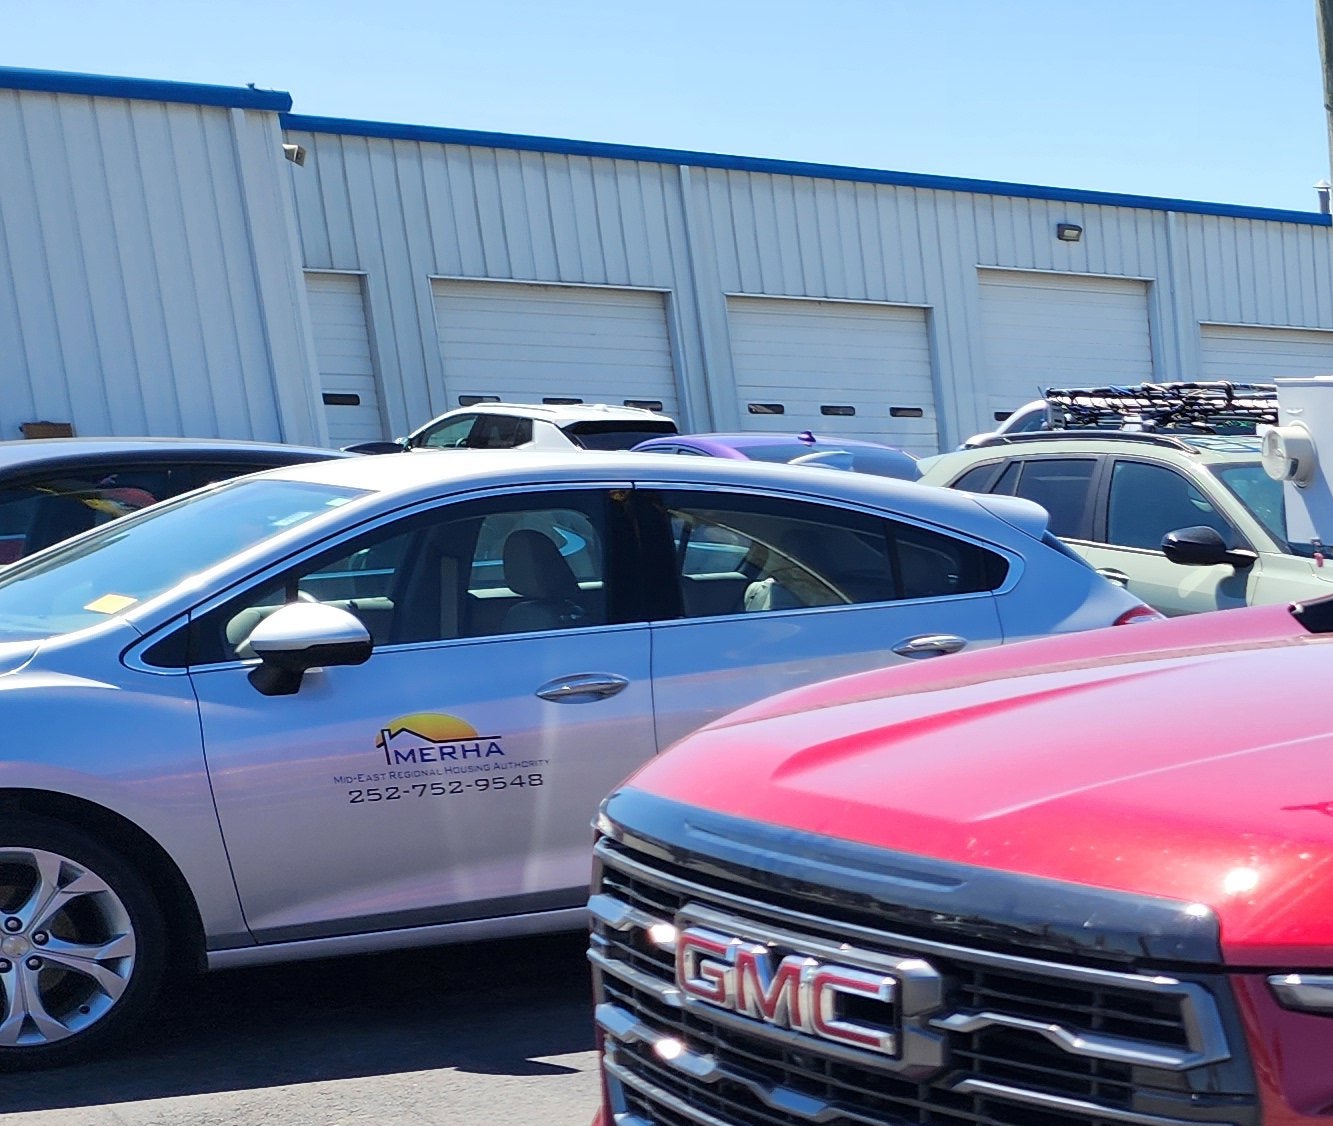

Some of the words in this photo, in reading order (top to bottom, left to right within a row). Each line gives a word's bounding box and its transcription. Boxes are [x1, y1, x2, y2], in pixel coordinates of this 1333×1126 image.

[394, 741, 506, 765] MERHA
[348, 773, 544, 804] 252-752-9548
[675, 926, 897, 1056] GMC
